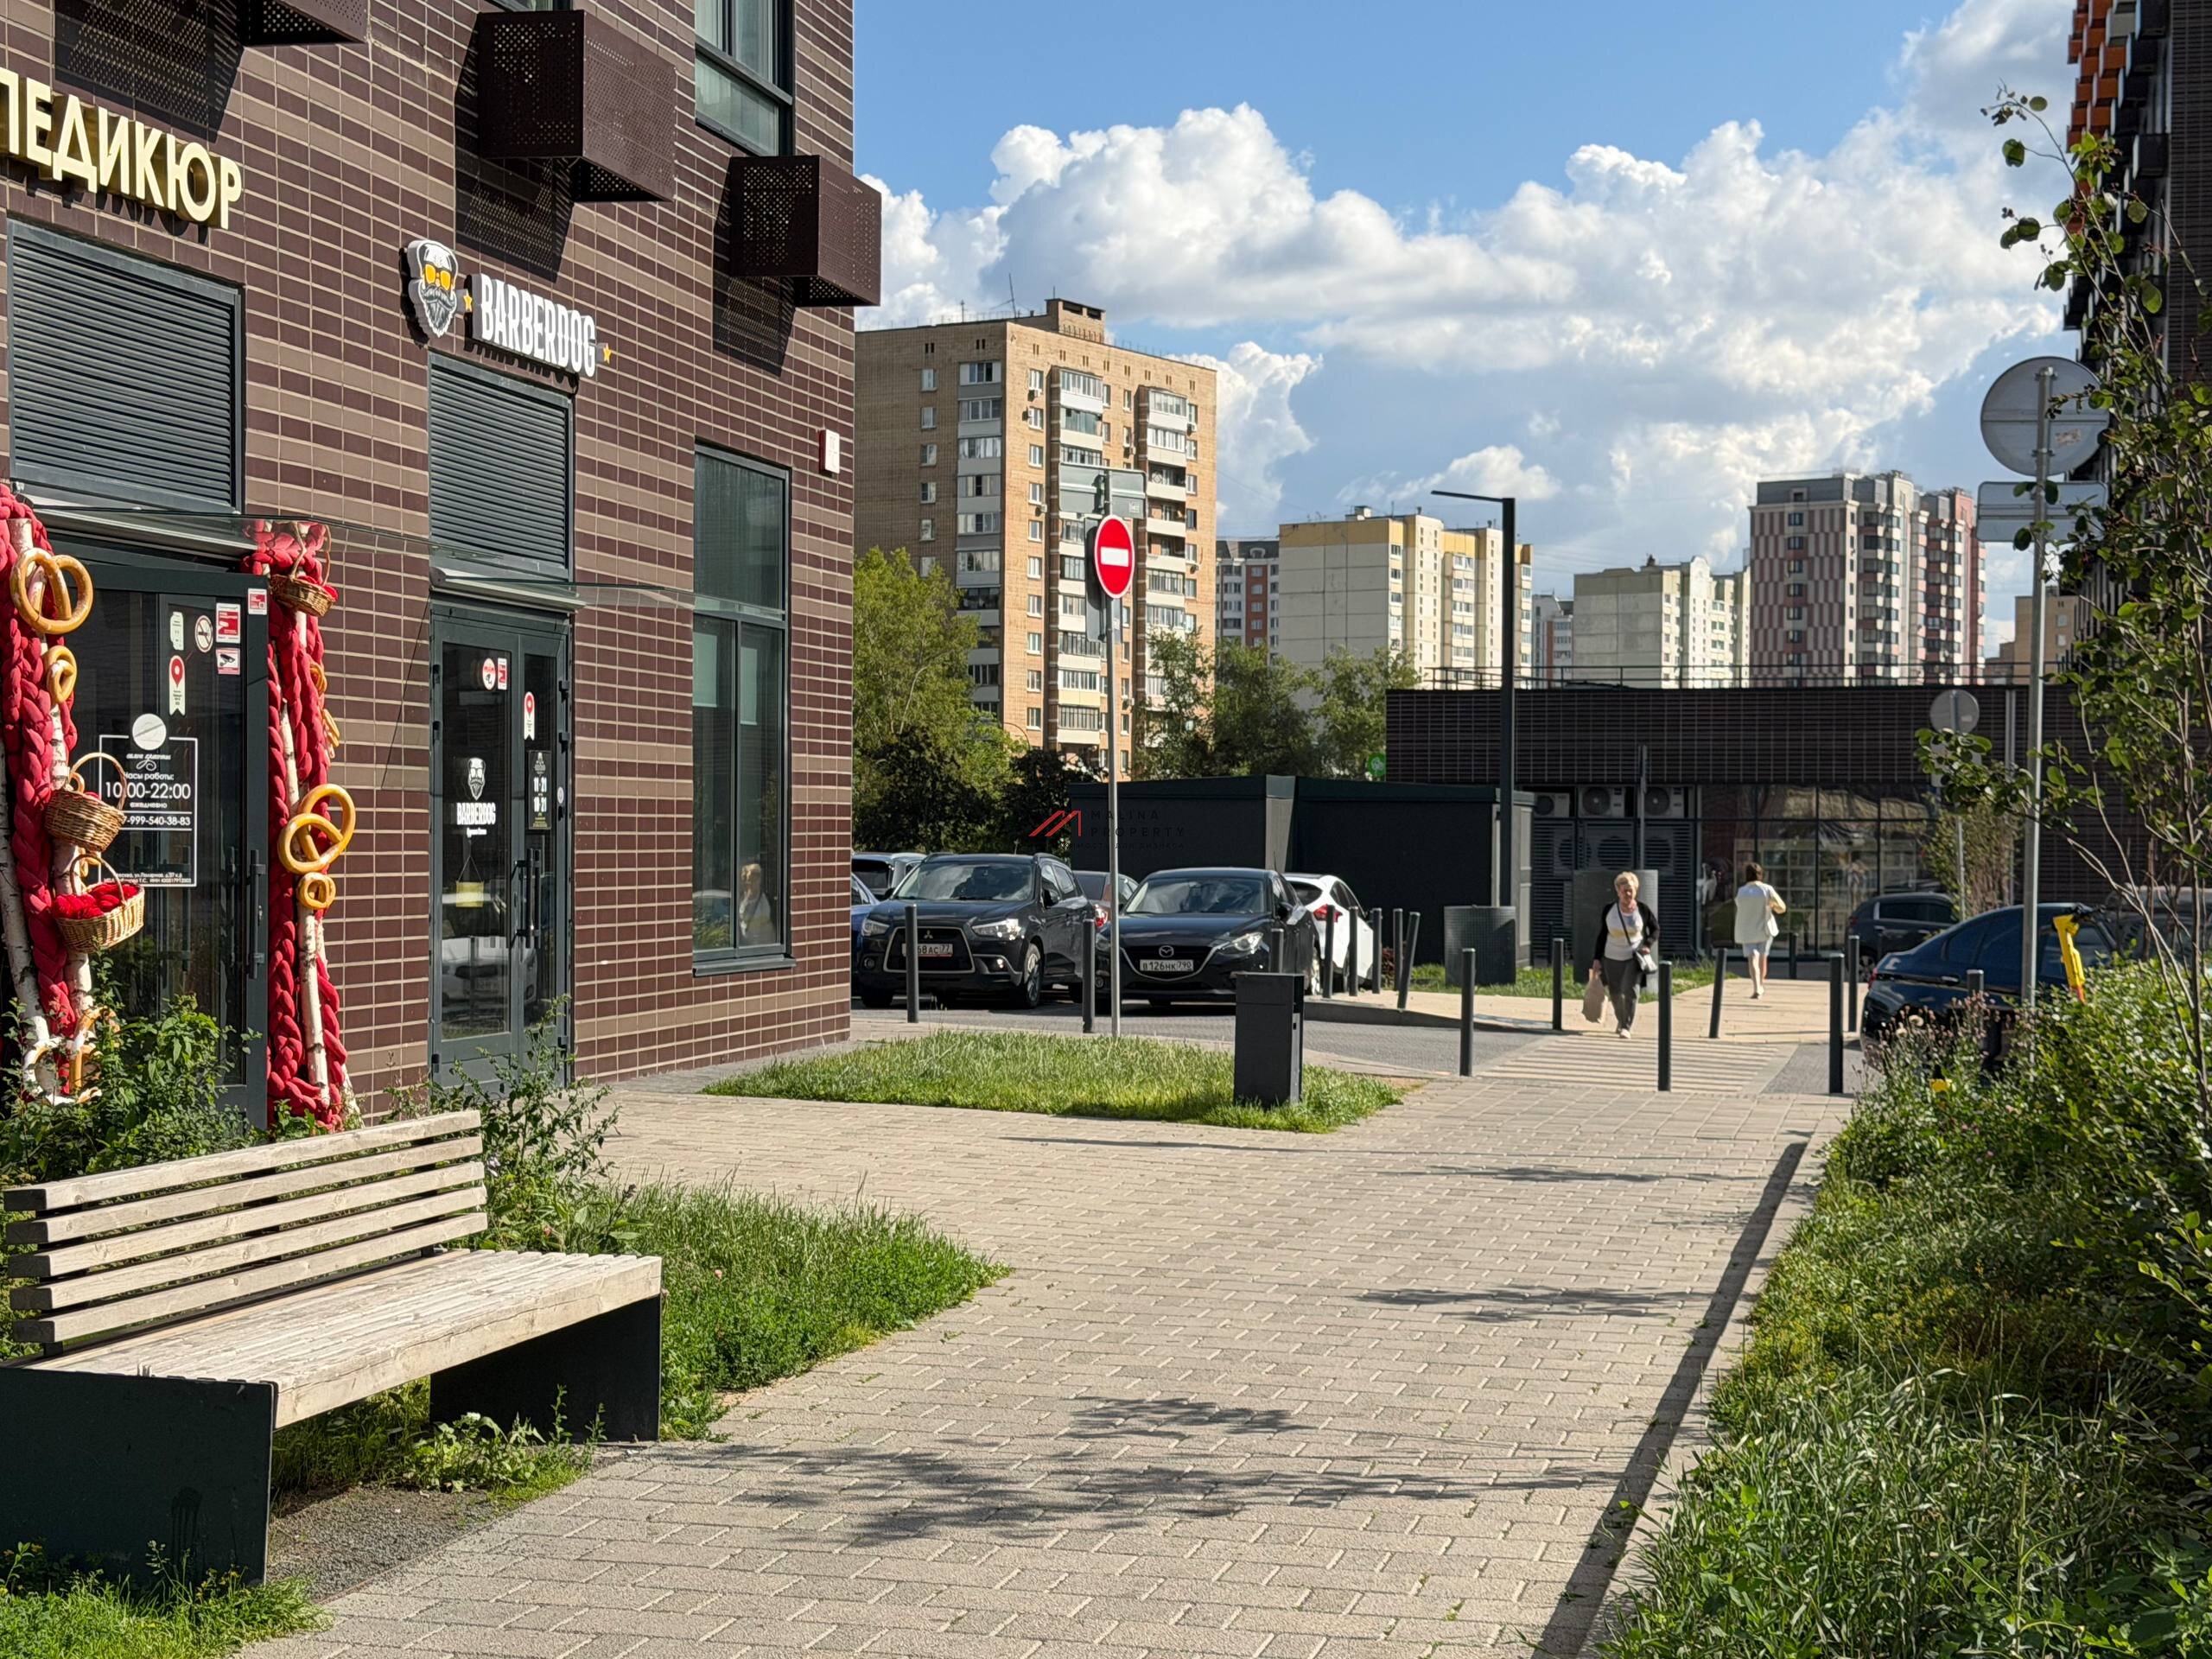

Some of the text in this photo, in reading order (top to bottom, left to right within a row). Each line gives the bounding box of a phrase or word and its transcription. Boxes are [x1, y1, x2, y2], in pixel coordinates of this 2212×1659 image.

[0, 67, 243, 230] ПЕДИКЮР
[480, 273, 596, 378] BARBERDOG
[105, 781, 191, 799] 1000-22:00
[457, 802, 496, 825] BARBERDOG
